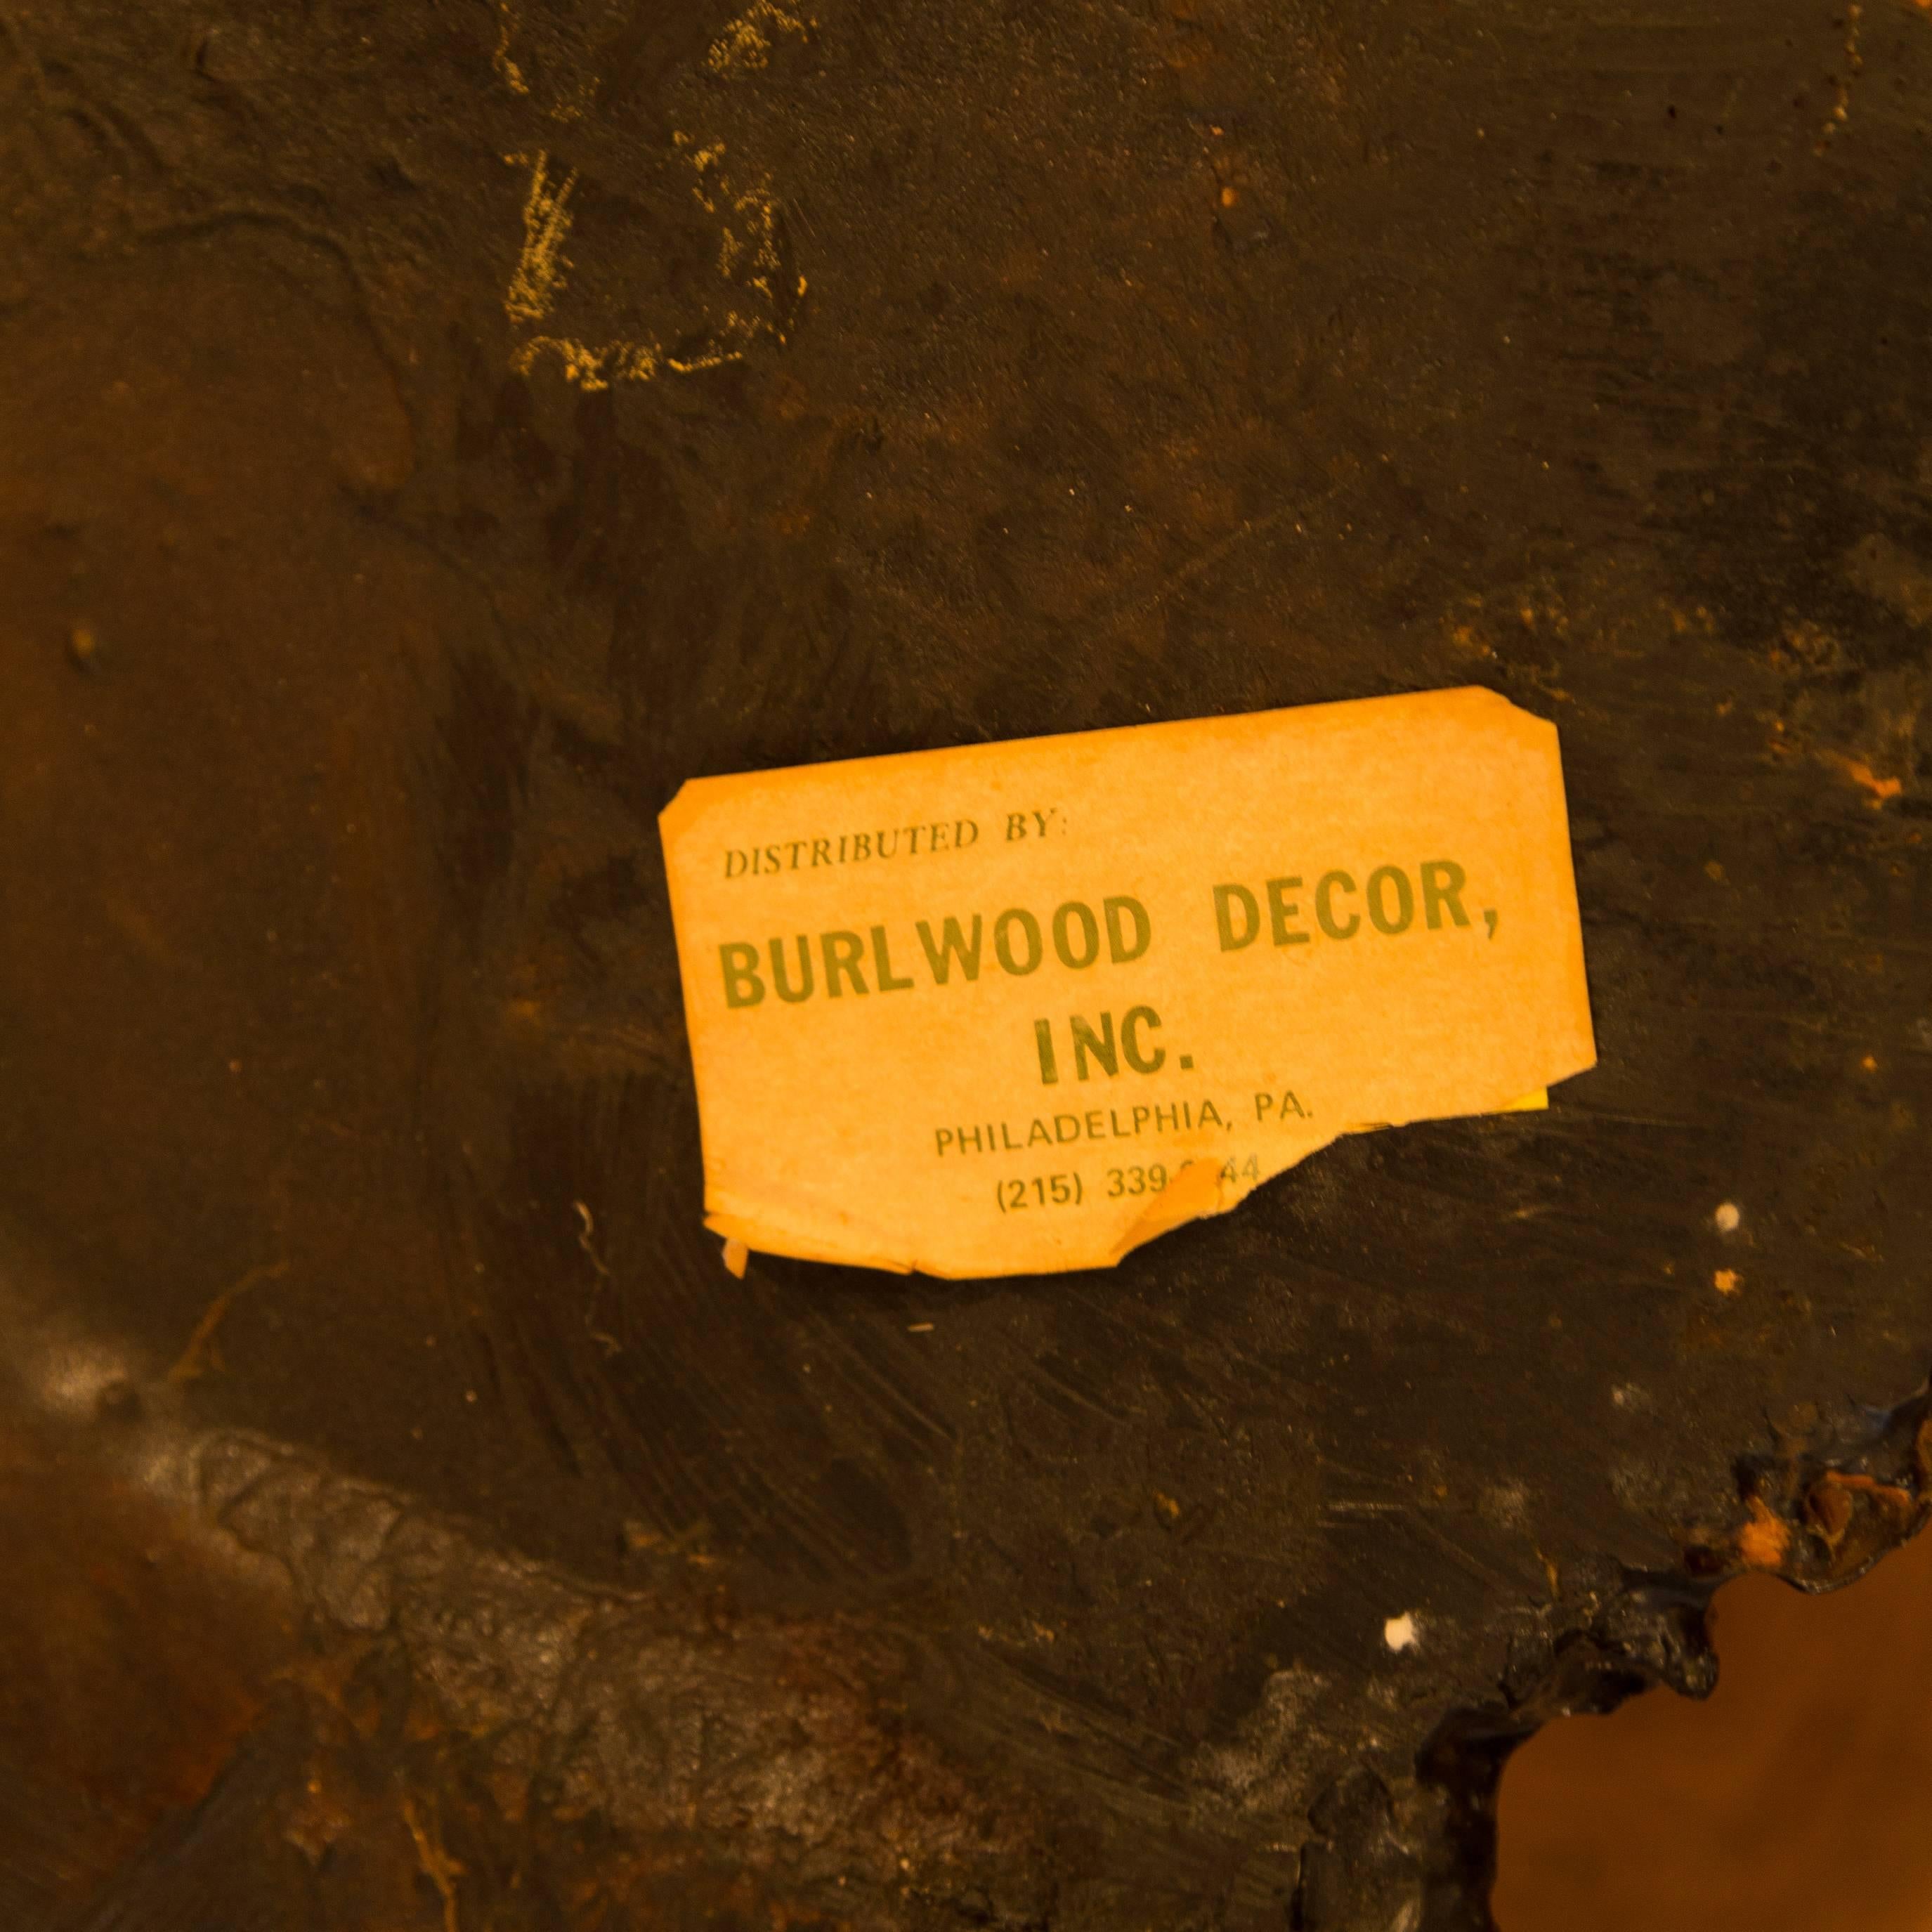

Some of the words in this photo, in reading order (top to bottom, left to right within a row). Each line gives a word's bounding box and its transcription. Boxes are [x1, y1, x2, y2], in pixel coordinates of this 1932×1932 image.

[724, 819, 979, 878] DISTRIBUTED
[1005, 807, 1068, 842] BY:
[719, 894, 1152, 1010] BURLWOOD
[1212, 859, 1498, 952] DECOR,
[1034, 1005, 1194, 1085] INC.
[934, 1099, 1234, 1157] PHILADELPHIA,
[1254, 1089, 1314, 1122] PA.
[996, 1172, 1083, 1213] (215)
[1107, 1152, 1260, 1199] 33944
